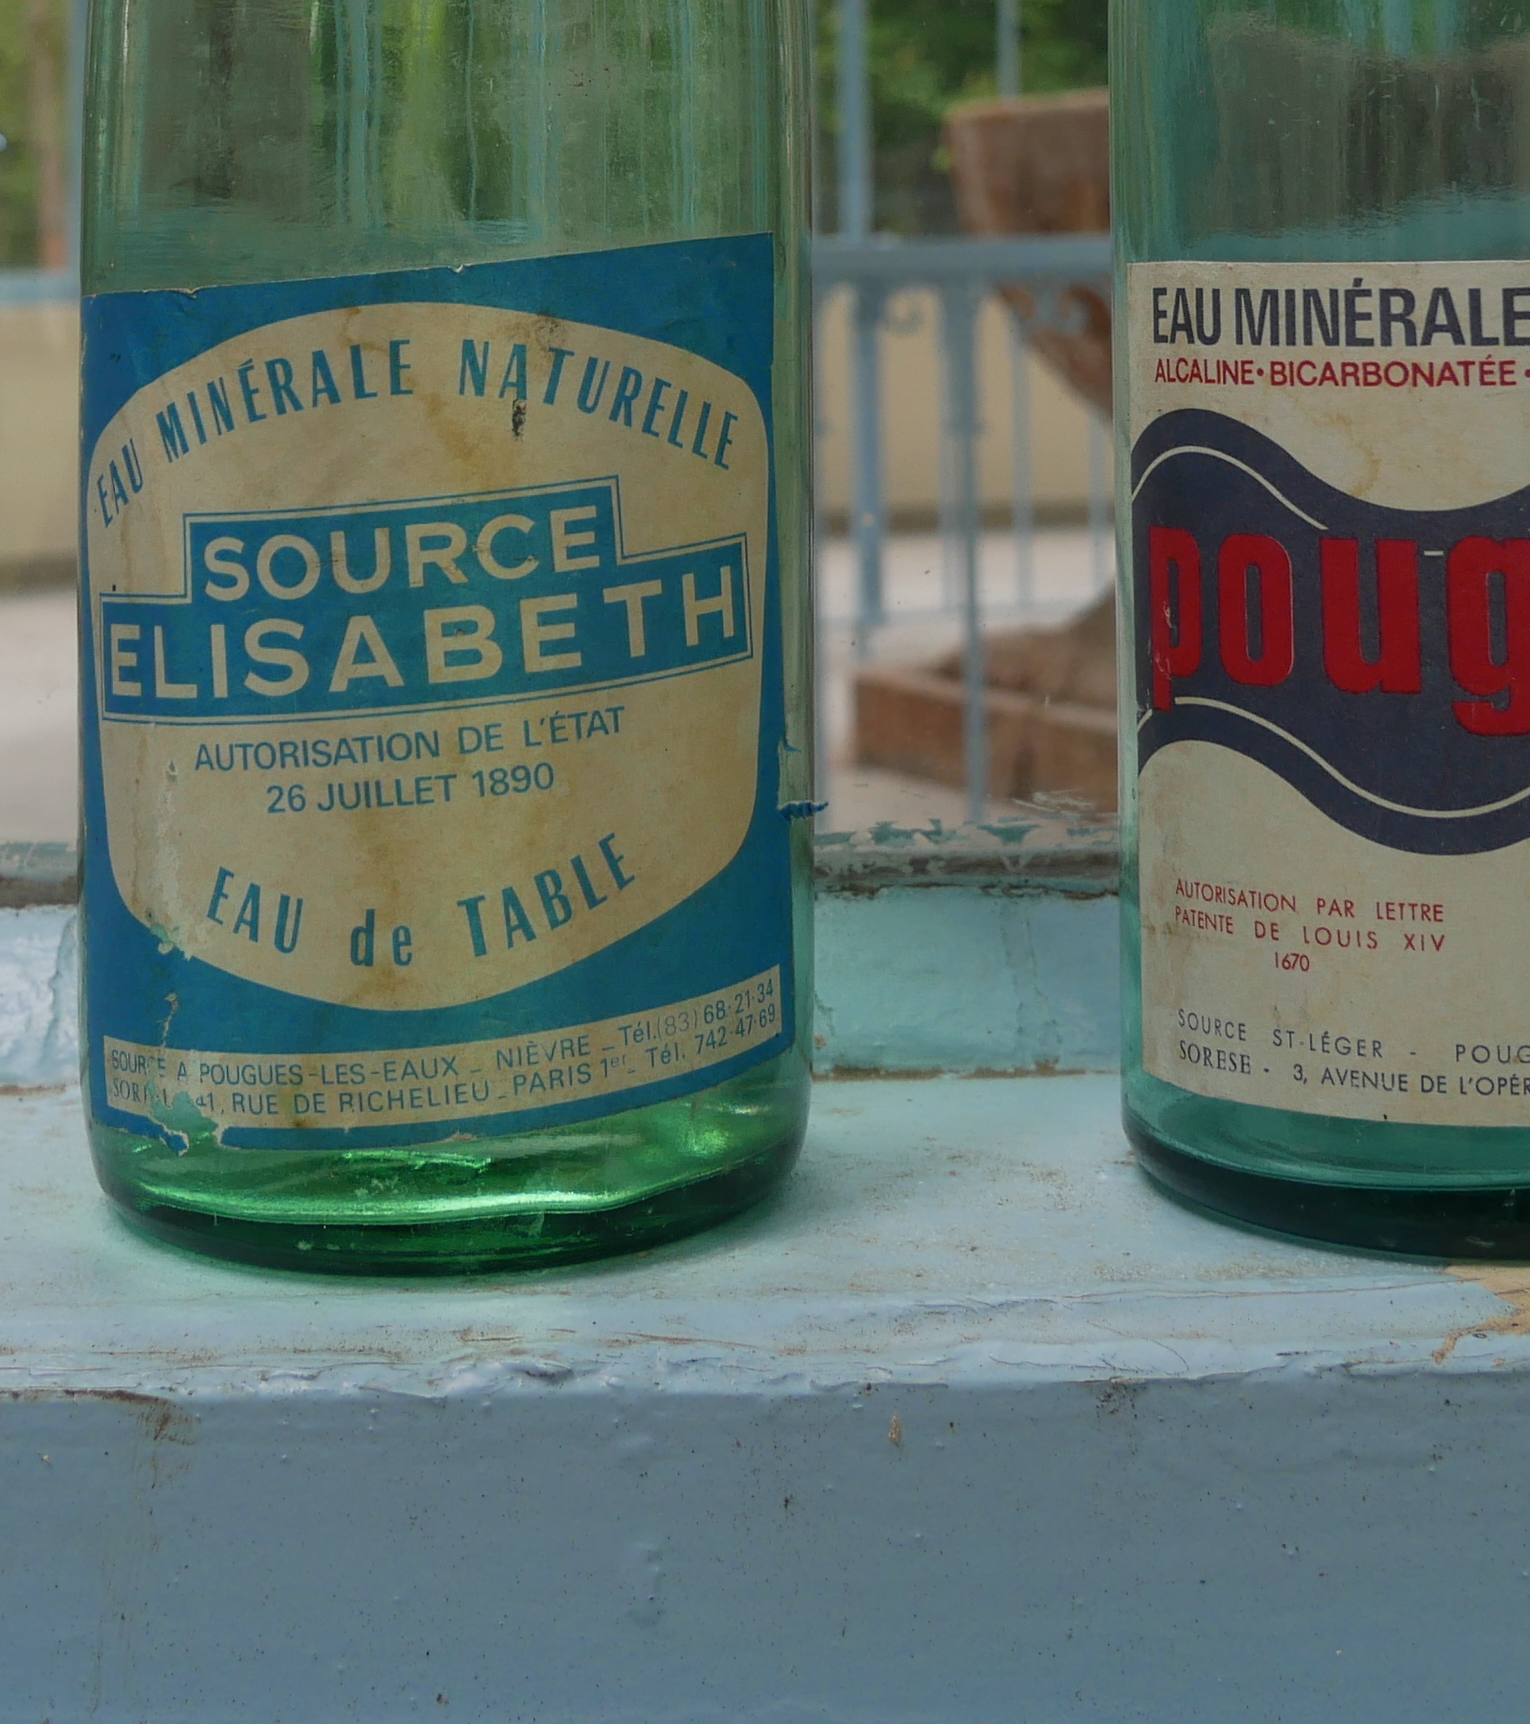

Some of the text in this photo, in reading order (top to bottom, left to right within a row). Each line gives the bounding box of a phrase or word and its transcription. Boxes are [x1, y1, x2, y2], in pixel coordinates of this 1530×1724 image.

[1153, 285, 1222, 346] EAU
[1154, 357, 1255, 386] ALCALINE
[1270, 353, 1517, 388] BICARBONATÉE
[96, 338, 739, 528] EAU MINÉRALE NATURELLE
[203, 504, 600, 602] SOURCE
[110, 564, 737, 699] ELISABETH
[195, 705, 626, 772] AUTORISATION DE L'ÉTAT
[266, 762, 555, 814] 26 JUILLET 1890
[206, 832, 636, 967] EAU de TABLE
[1175, 878, 1444, 923] AUTORISATION PAR LETTRE
[1174, 905, 1446, 952] PATENTE DE LOUIS XIV
[1274, 951, 1311, 973] 1670
[1177, 1007, 1248, 1042] SOURCE
[177, 1061, 188, 1082] A
[496, 1035, 592, 1071] NIÈVRE
[1179, 1038, 1252, 1075] SORESE
[1293, 1064, 1308, 1085] 3,
[1320, 1067, 1409, 1093] AVENUE
[1421, 1075, 1448, 1095] DE
[232, 1092, 279, 1116] RUE
[293, 1092, 327, 1115] DE
[339, 1080, 490, 1114] RICHELIEU
[512, 1063, 593, 1096] PARIS
